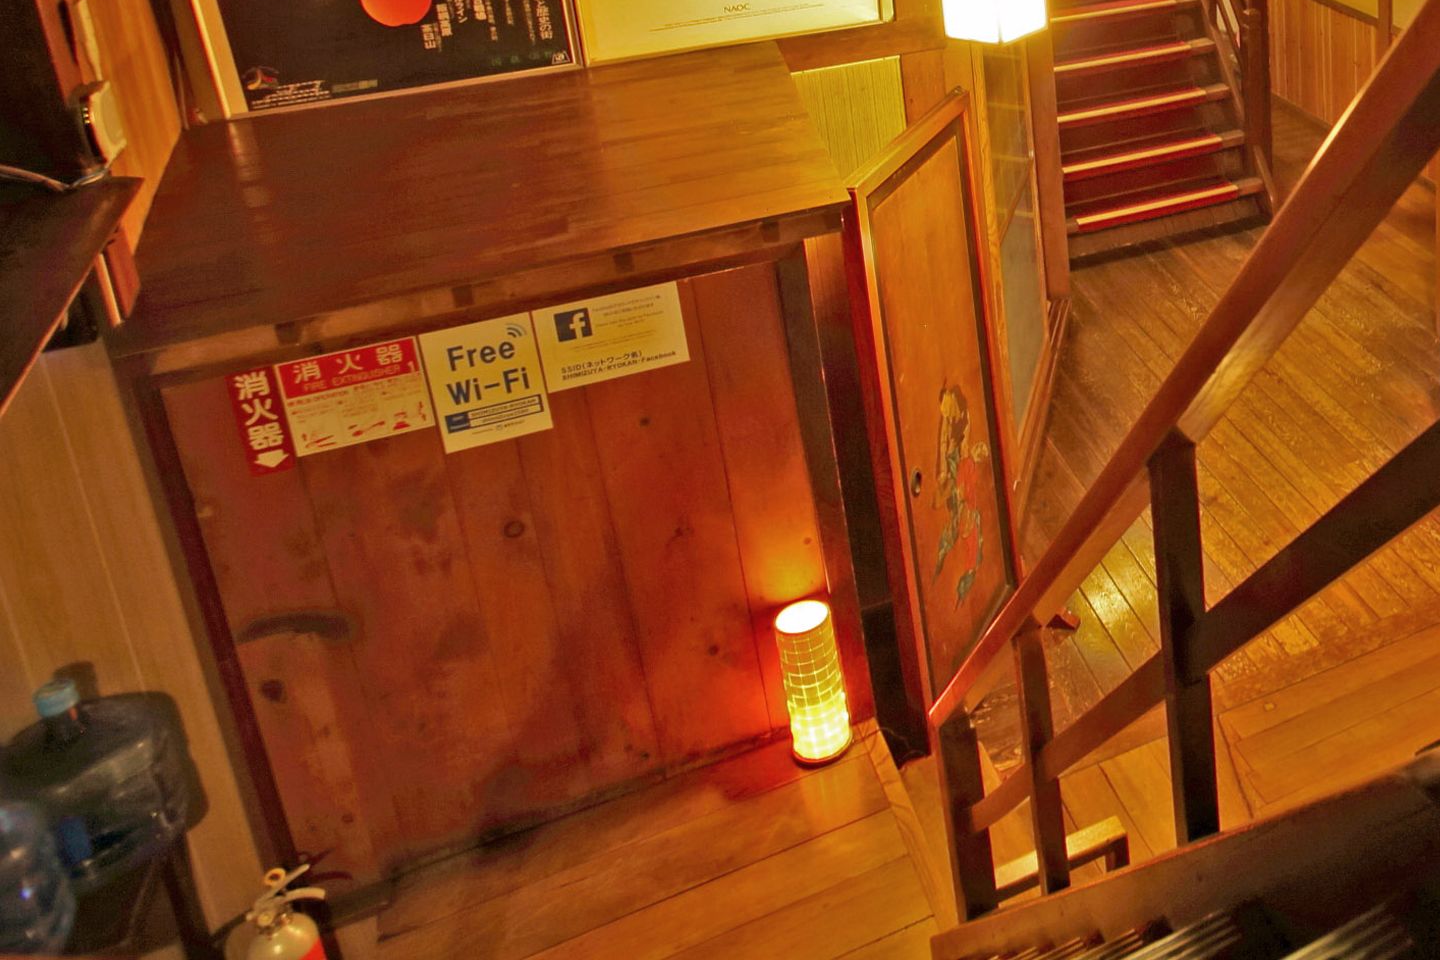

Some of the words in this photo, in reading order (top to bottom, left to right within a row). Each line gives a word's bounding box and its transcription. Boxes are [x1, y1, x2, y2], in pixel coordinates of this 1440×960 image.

[292, 343, 403, 385] 消火器
[446, 338, 516, 373] Free
[303, 378, 328, 392] FIRE
[446, 367, 530, 406] Wi-Fi
[233, 369, 285, 452] 消火器
